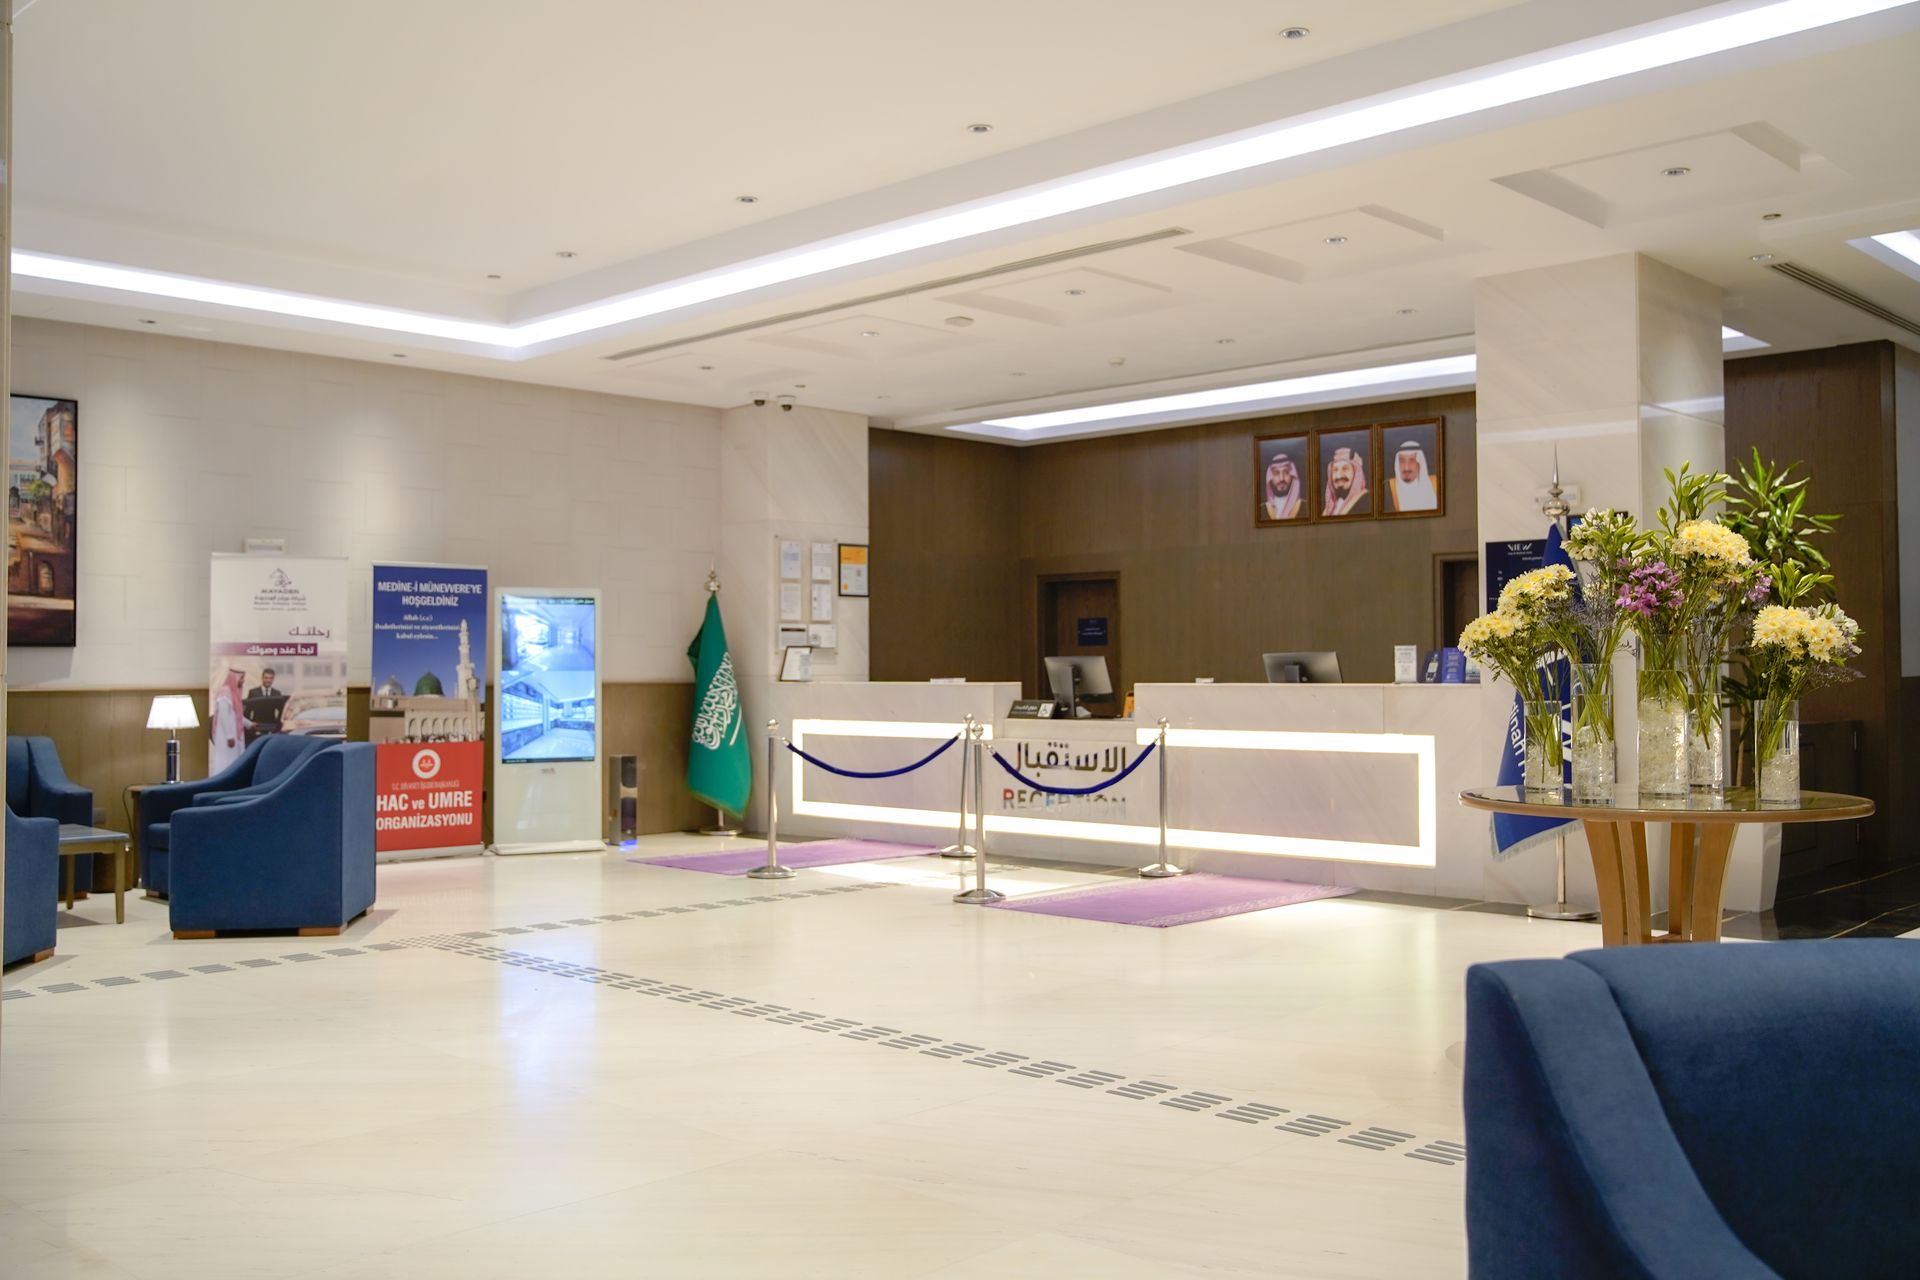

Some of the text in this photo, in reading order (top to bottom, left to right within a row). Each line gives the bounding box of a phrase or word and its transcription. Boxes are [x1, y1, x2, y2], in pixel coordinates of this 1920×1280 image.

[402, 595, 459, 607] HOŞGELDİNİZ
[1015, 742, 1127, 777] الاستقبال
[376, 790, 473, 812] HAC ve UMRE
[375, 812, 473, 831] ORGANİZASYONU
